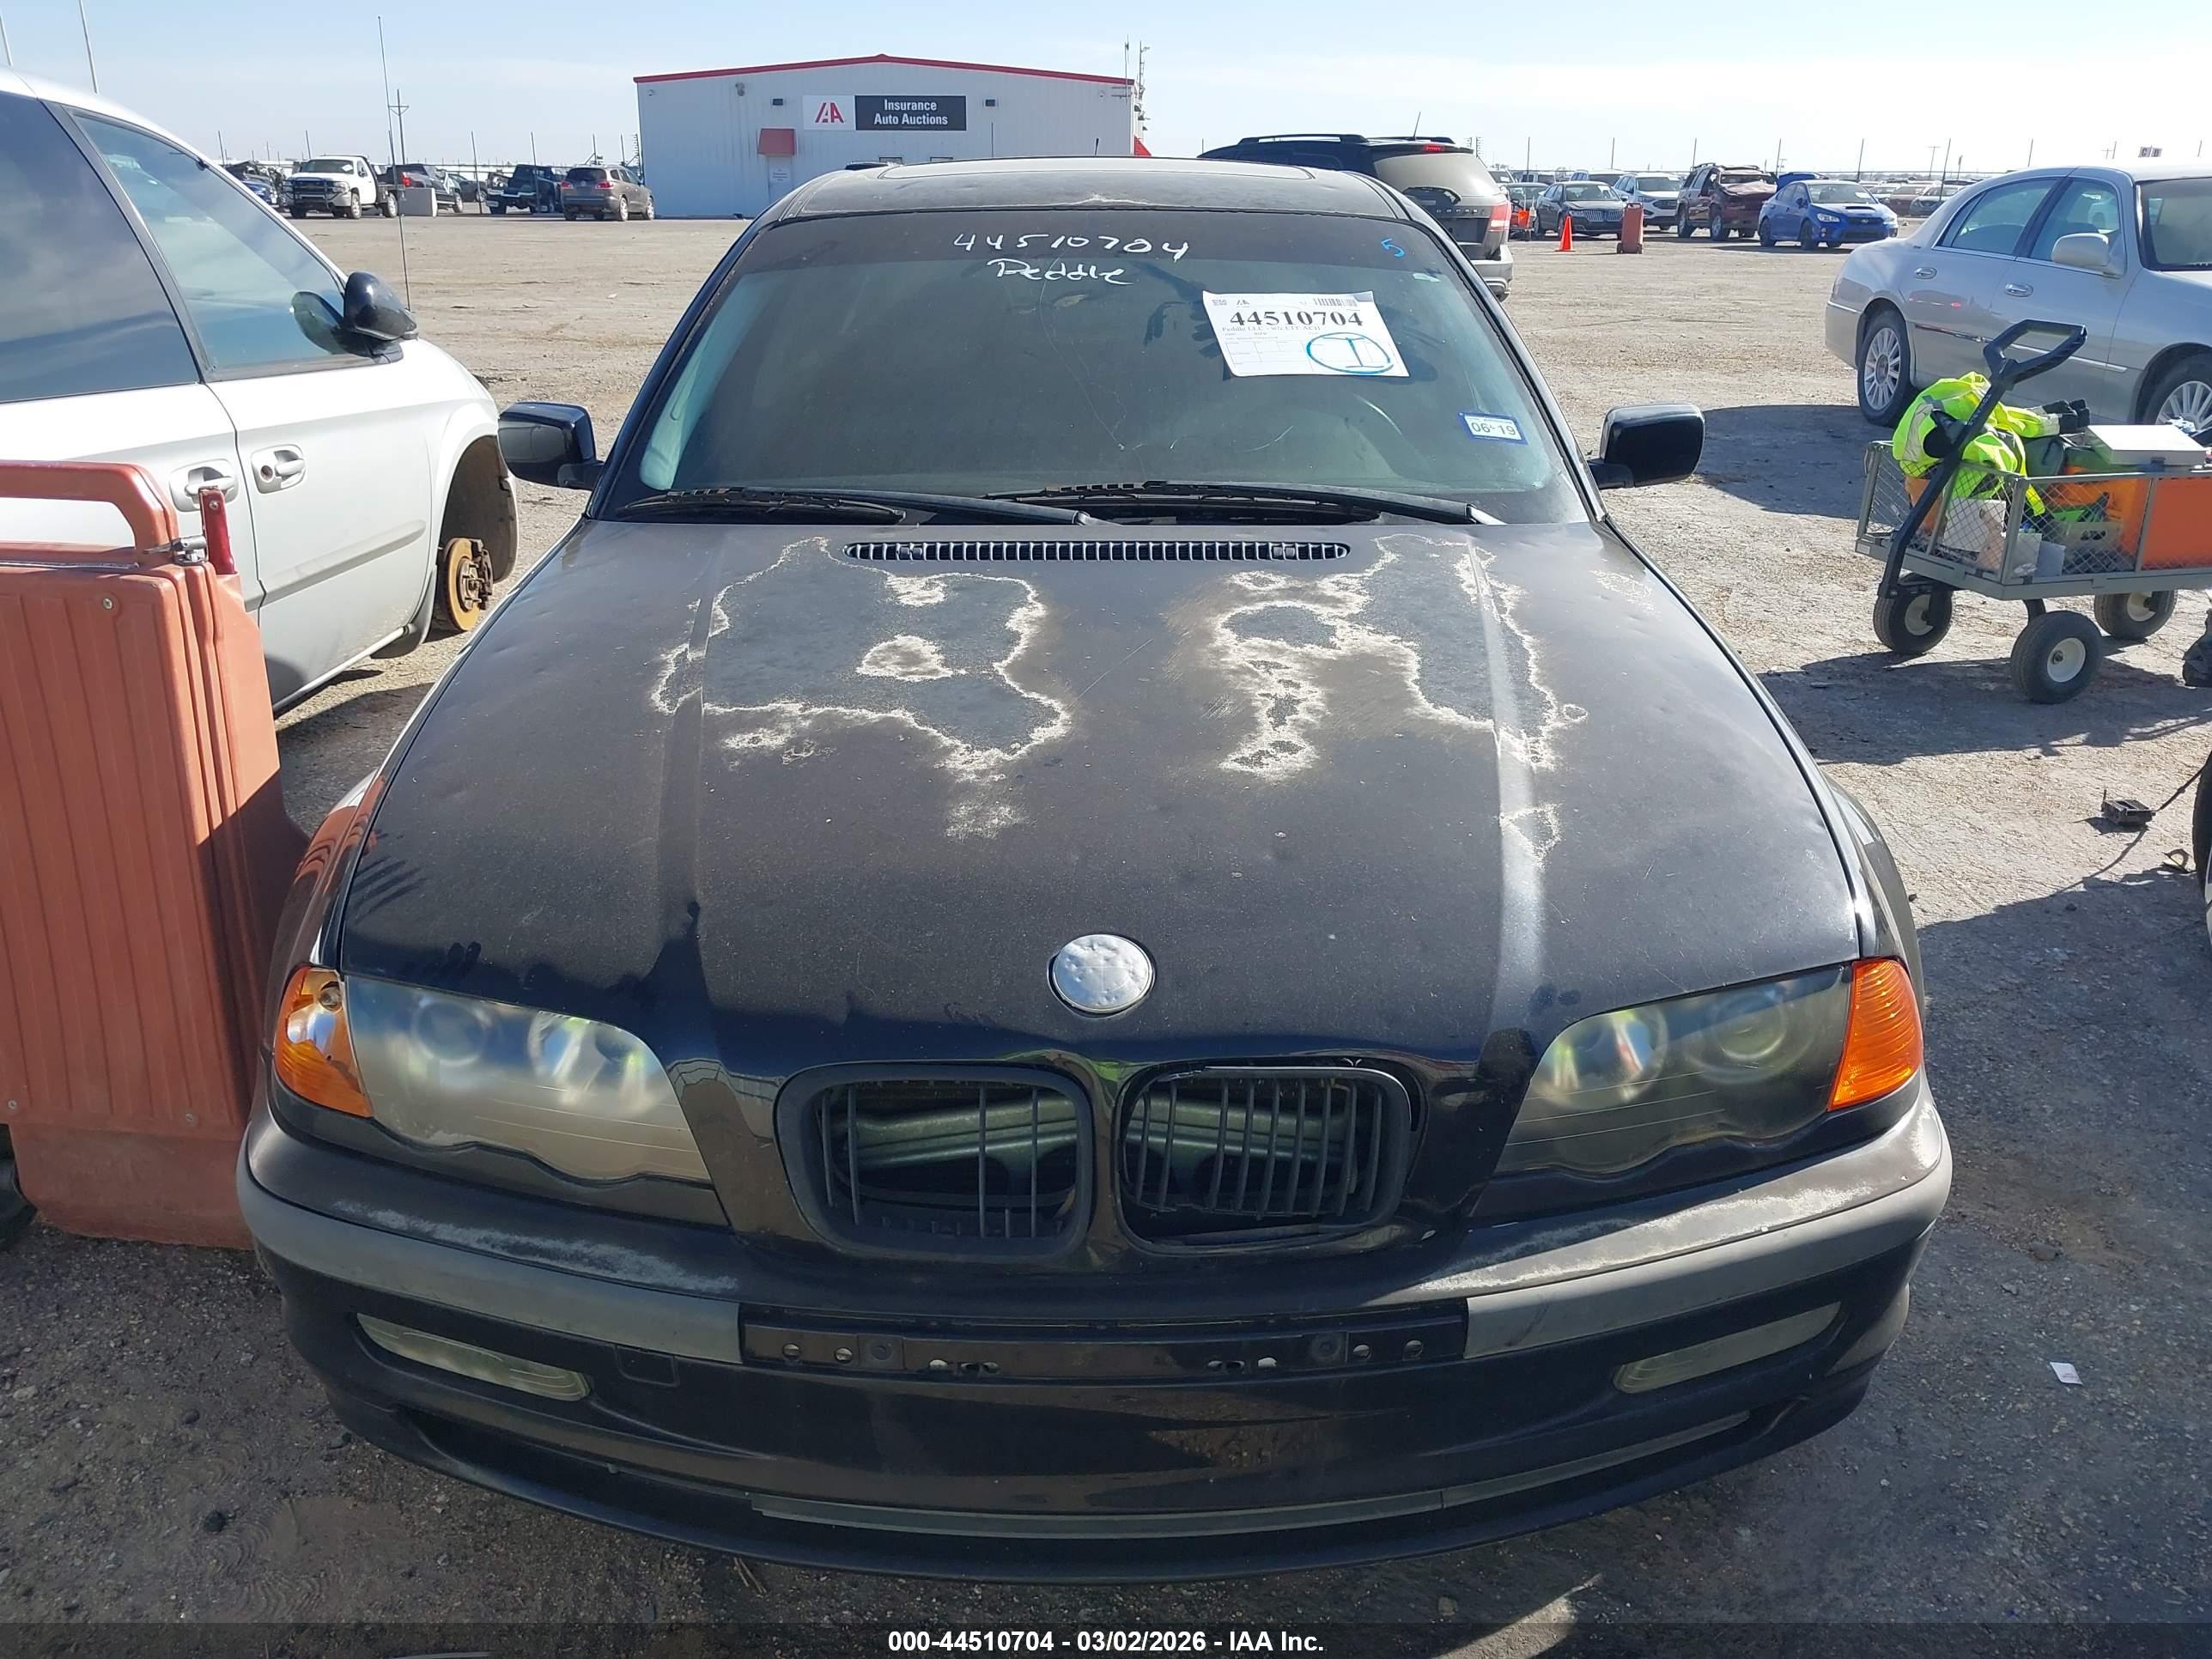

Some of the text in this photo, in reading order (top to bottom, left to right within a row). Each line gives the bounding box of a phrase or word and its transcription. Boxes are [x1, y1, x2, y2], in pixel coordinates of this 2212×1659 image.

[884, 99, 938, 111] Insurance
[873, 113, 949, 125] Auto Auctions
[953, 234, 1189, 263] 44510704
[1230, 311, 1364, 326] 44510704
